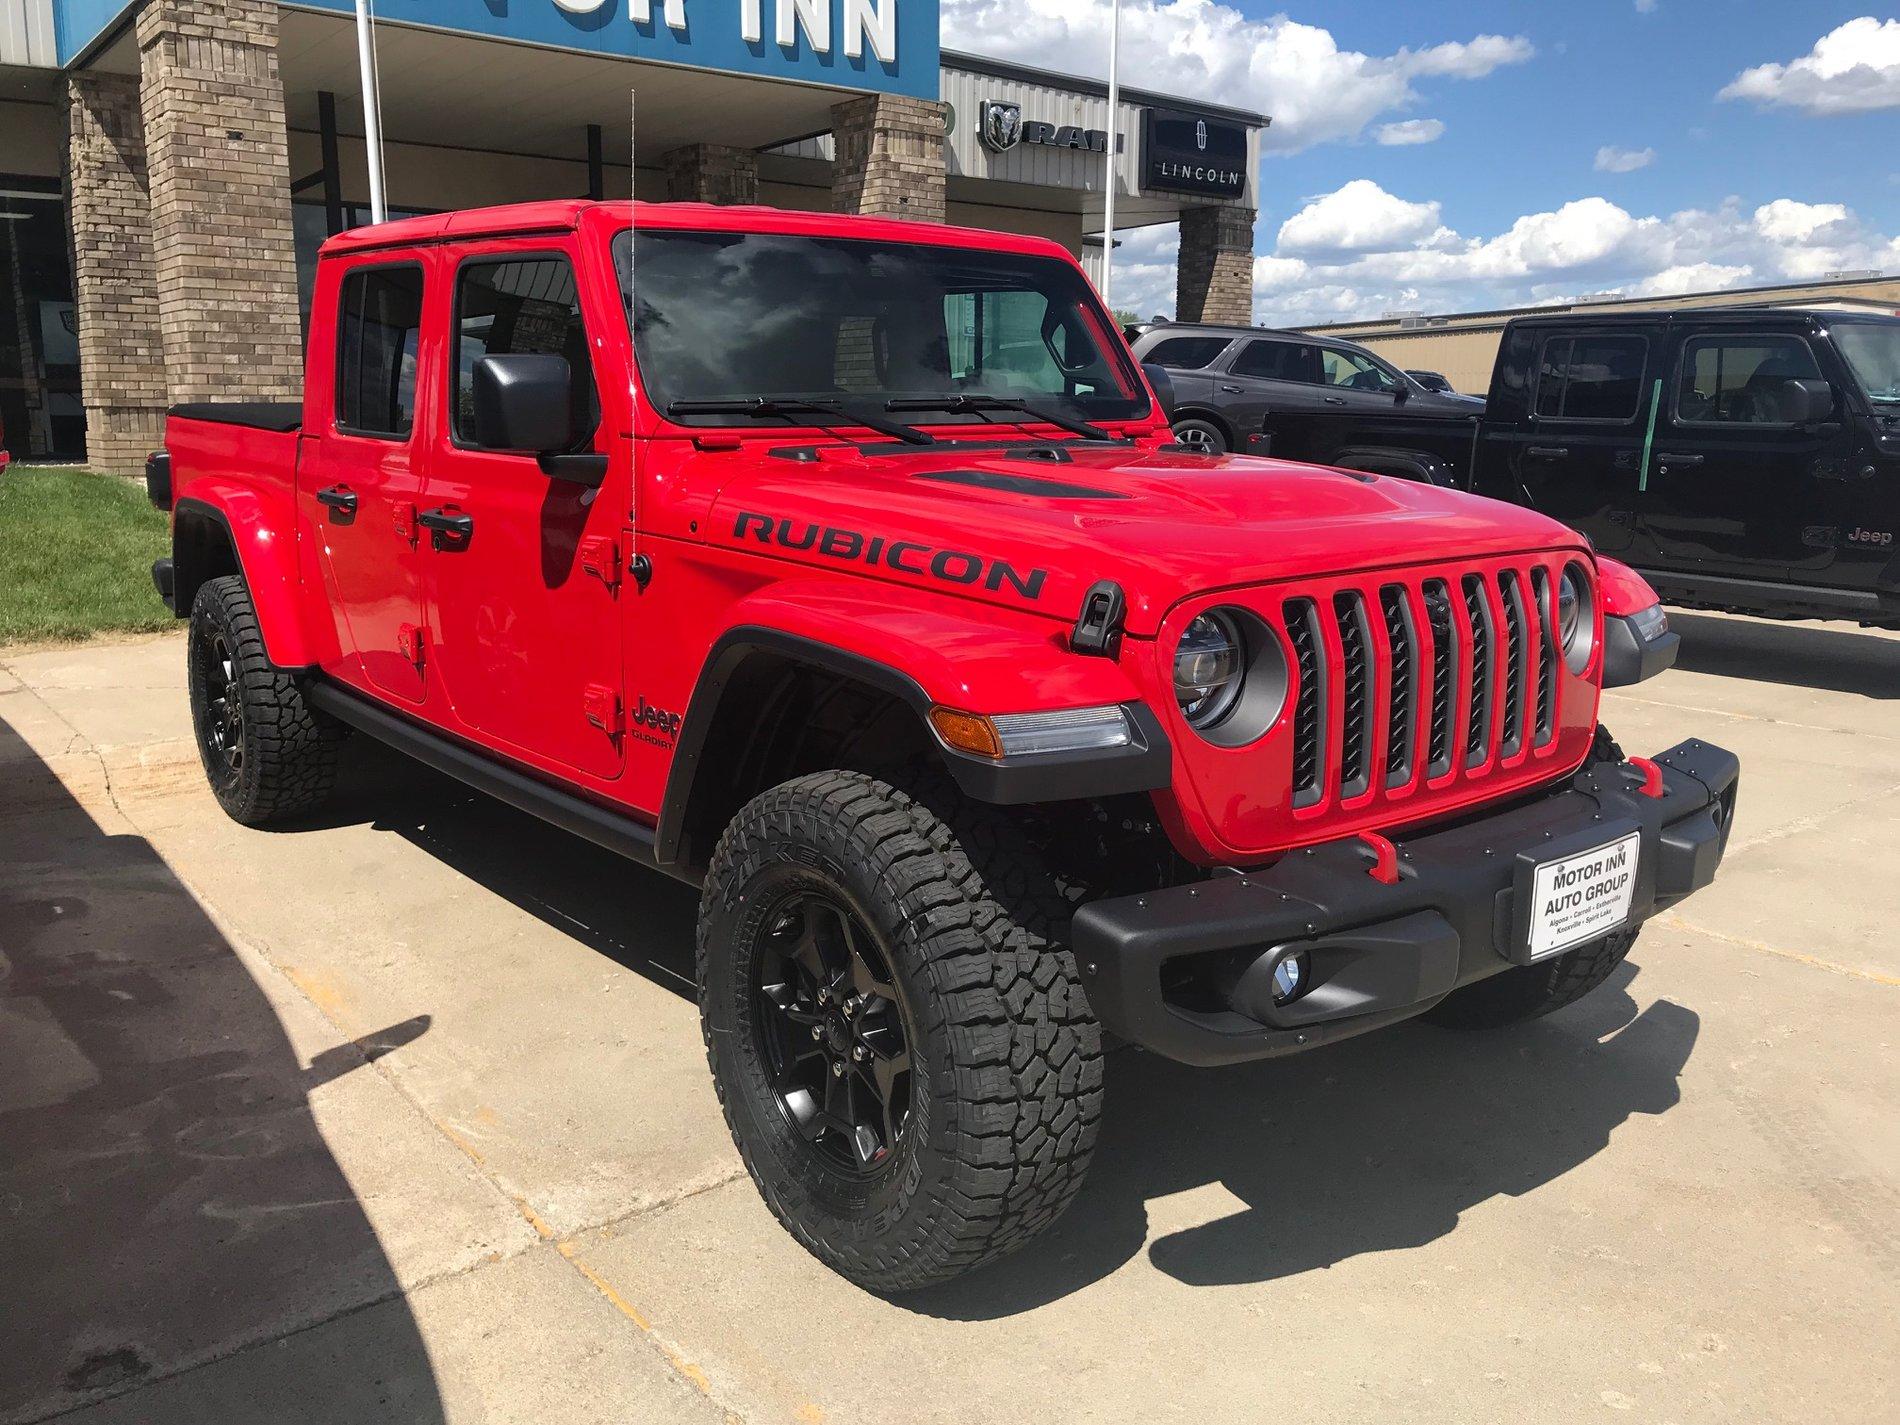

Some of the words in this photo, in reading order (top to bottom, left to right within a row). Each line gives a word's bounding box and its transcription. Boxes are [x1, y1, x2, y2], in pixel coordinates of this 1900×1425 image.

[741, 0, 895, 63] INN
[1162, 162, 1238, 185] LINCOLN
[1848, 527, 1893, 546] Jeep
[733, 511, 1047, 600] RUBICON
[631, 728, 674, 750] GLADIAT
[1553, 861, 1602, 891] MOTOR
[1605, 851, 1626, 873] INN
[1544, 890, 1582, 916] AUTO
[1585, 872, 1629, 901] GROUP
[1549, 916, 1569, 928] Algona
[1556, 920, 1582, 935] Knoxville
[1600, 908, 1613, 918] Lake
